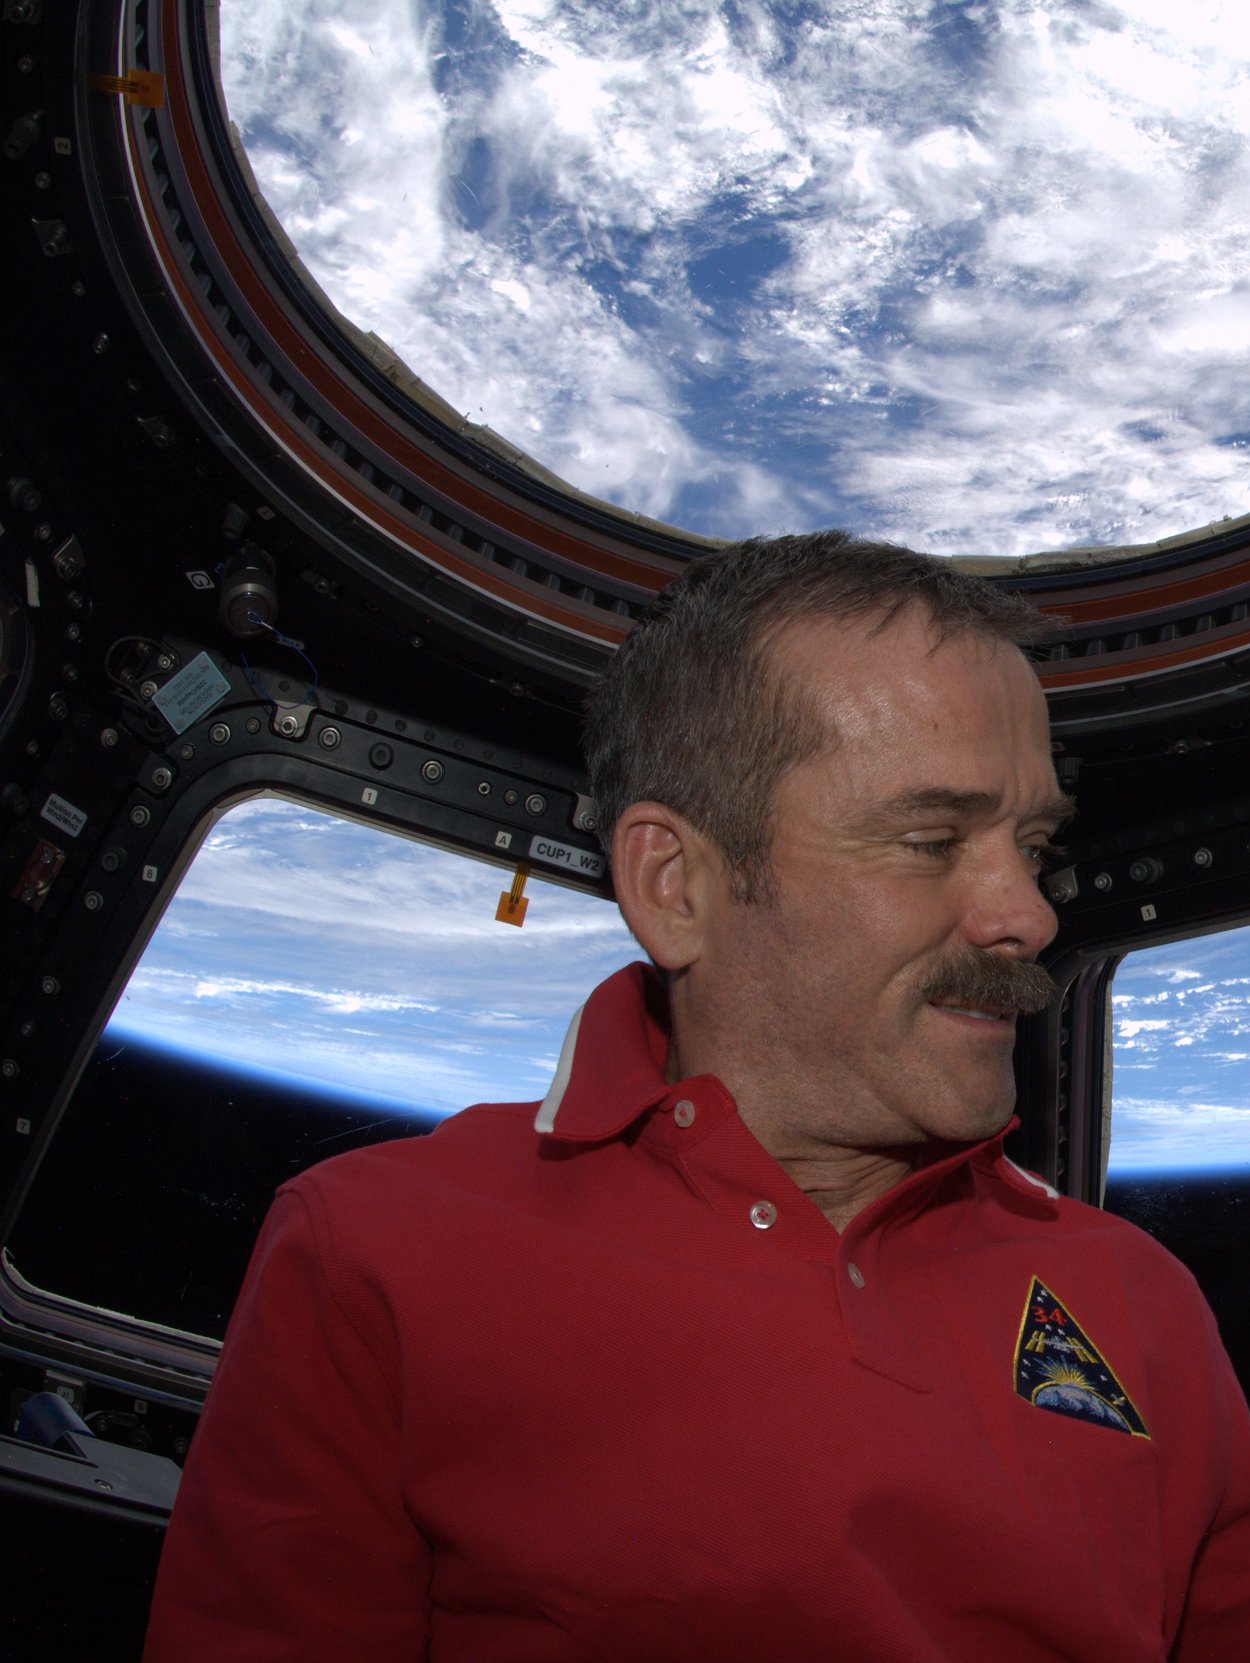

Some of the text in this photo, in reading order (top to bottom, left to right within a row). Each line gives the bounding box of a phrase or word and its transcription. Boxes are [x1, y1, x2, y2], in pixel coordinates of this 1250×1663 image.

[191, 573, 211, 587] G
[367, 792, 372, 801] 1
[500, 836, 507, 845] A
[537, 843, 600, 871] CUP1_W2
[147, 870, 153, 879] 8
[1145, 909, 1151, 918] 1
[21, 1122, 27, 1130] 7
[1032, 1305, 1065, 1327] 34
